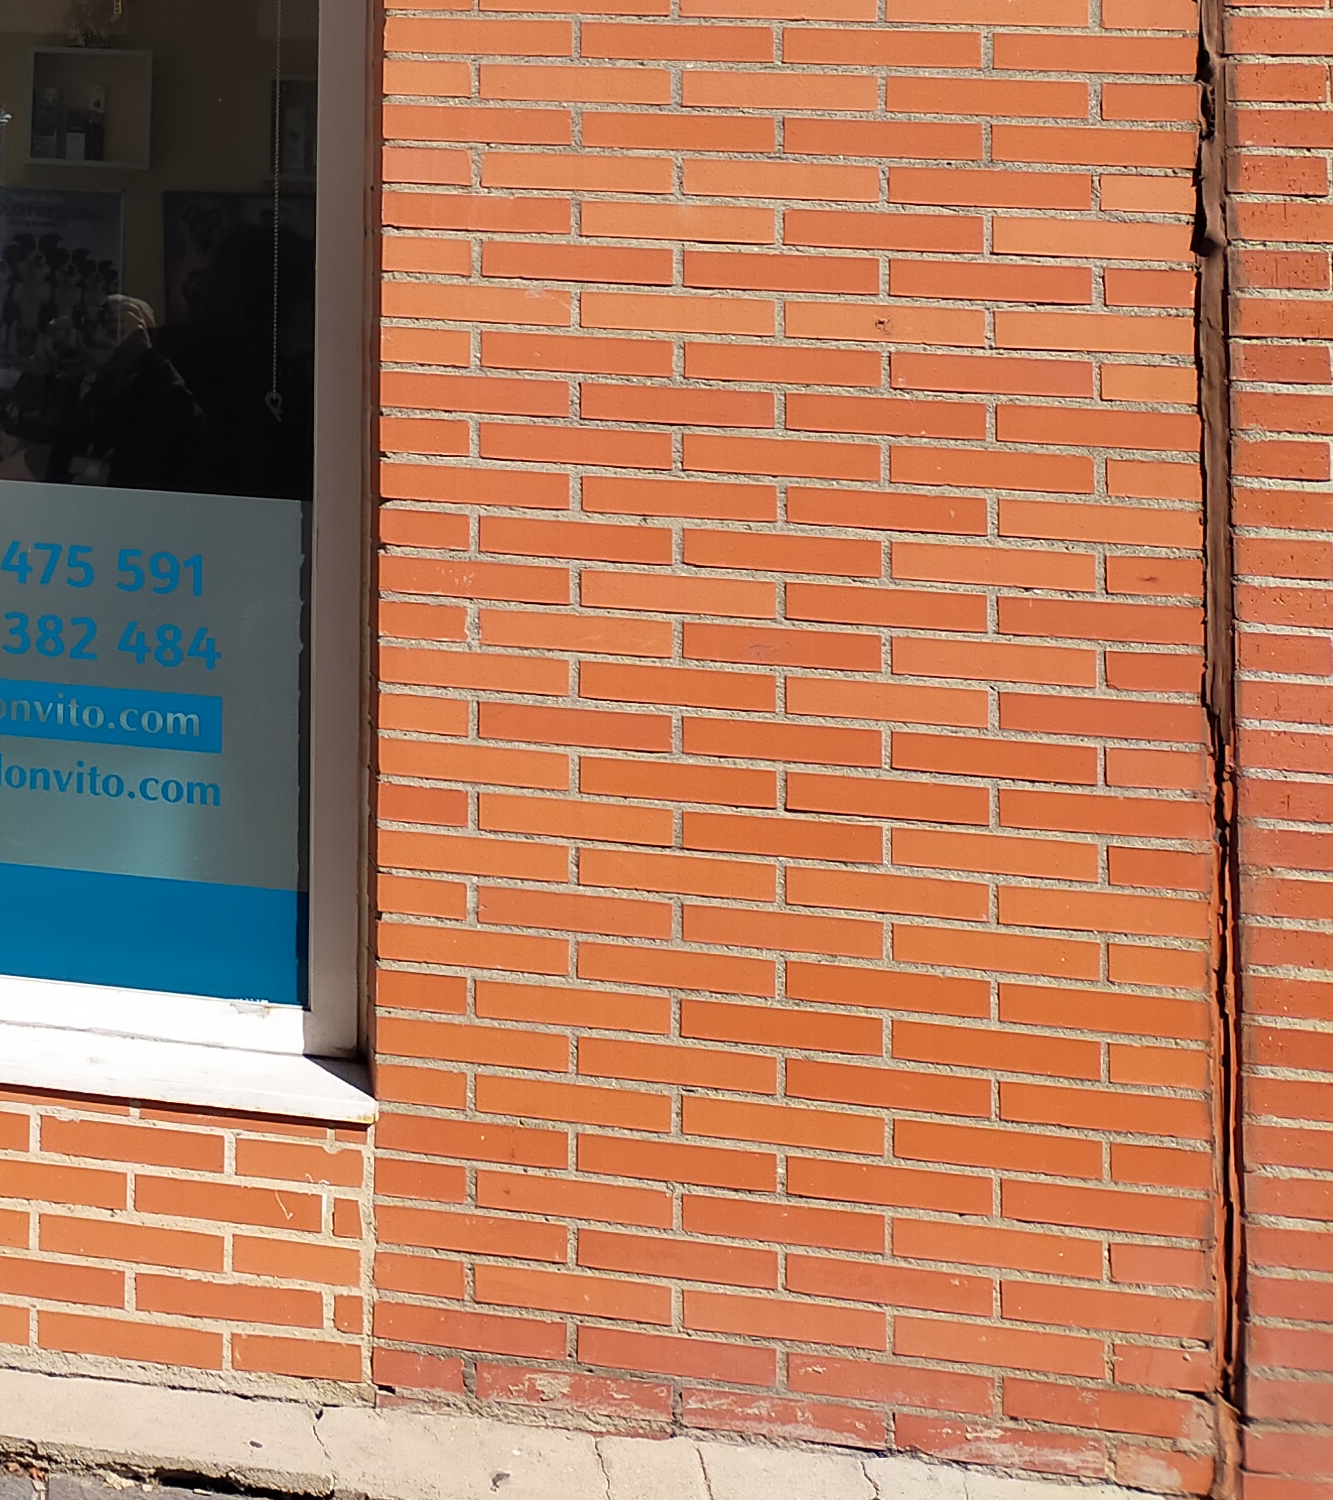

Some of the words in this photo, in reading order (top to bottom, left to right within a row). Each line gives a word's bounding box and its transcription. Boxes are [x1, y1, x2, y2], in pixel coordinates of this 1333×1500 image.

[0, 541, 95, 588] 475
[115, 549, 204, 597] 591
[2, 611, 99, 660] 382
[118, 620, 222, 670] 484
